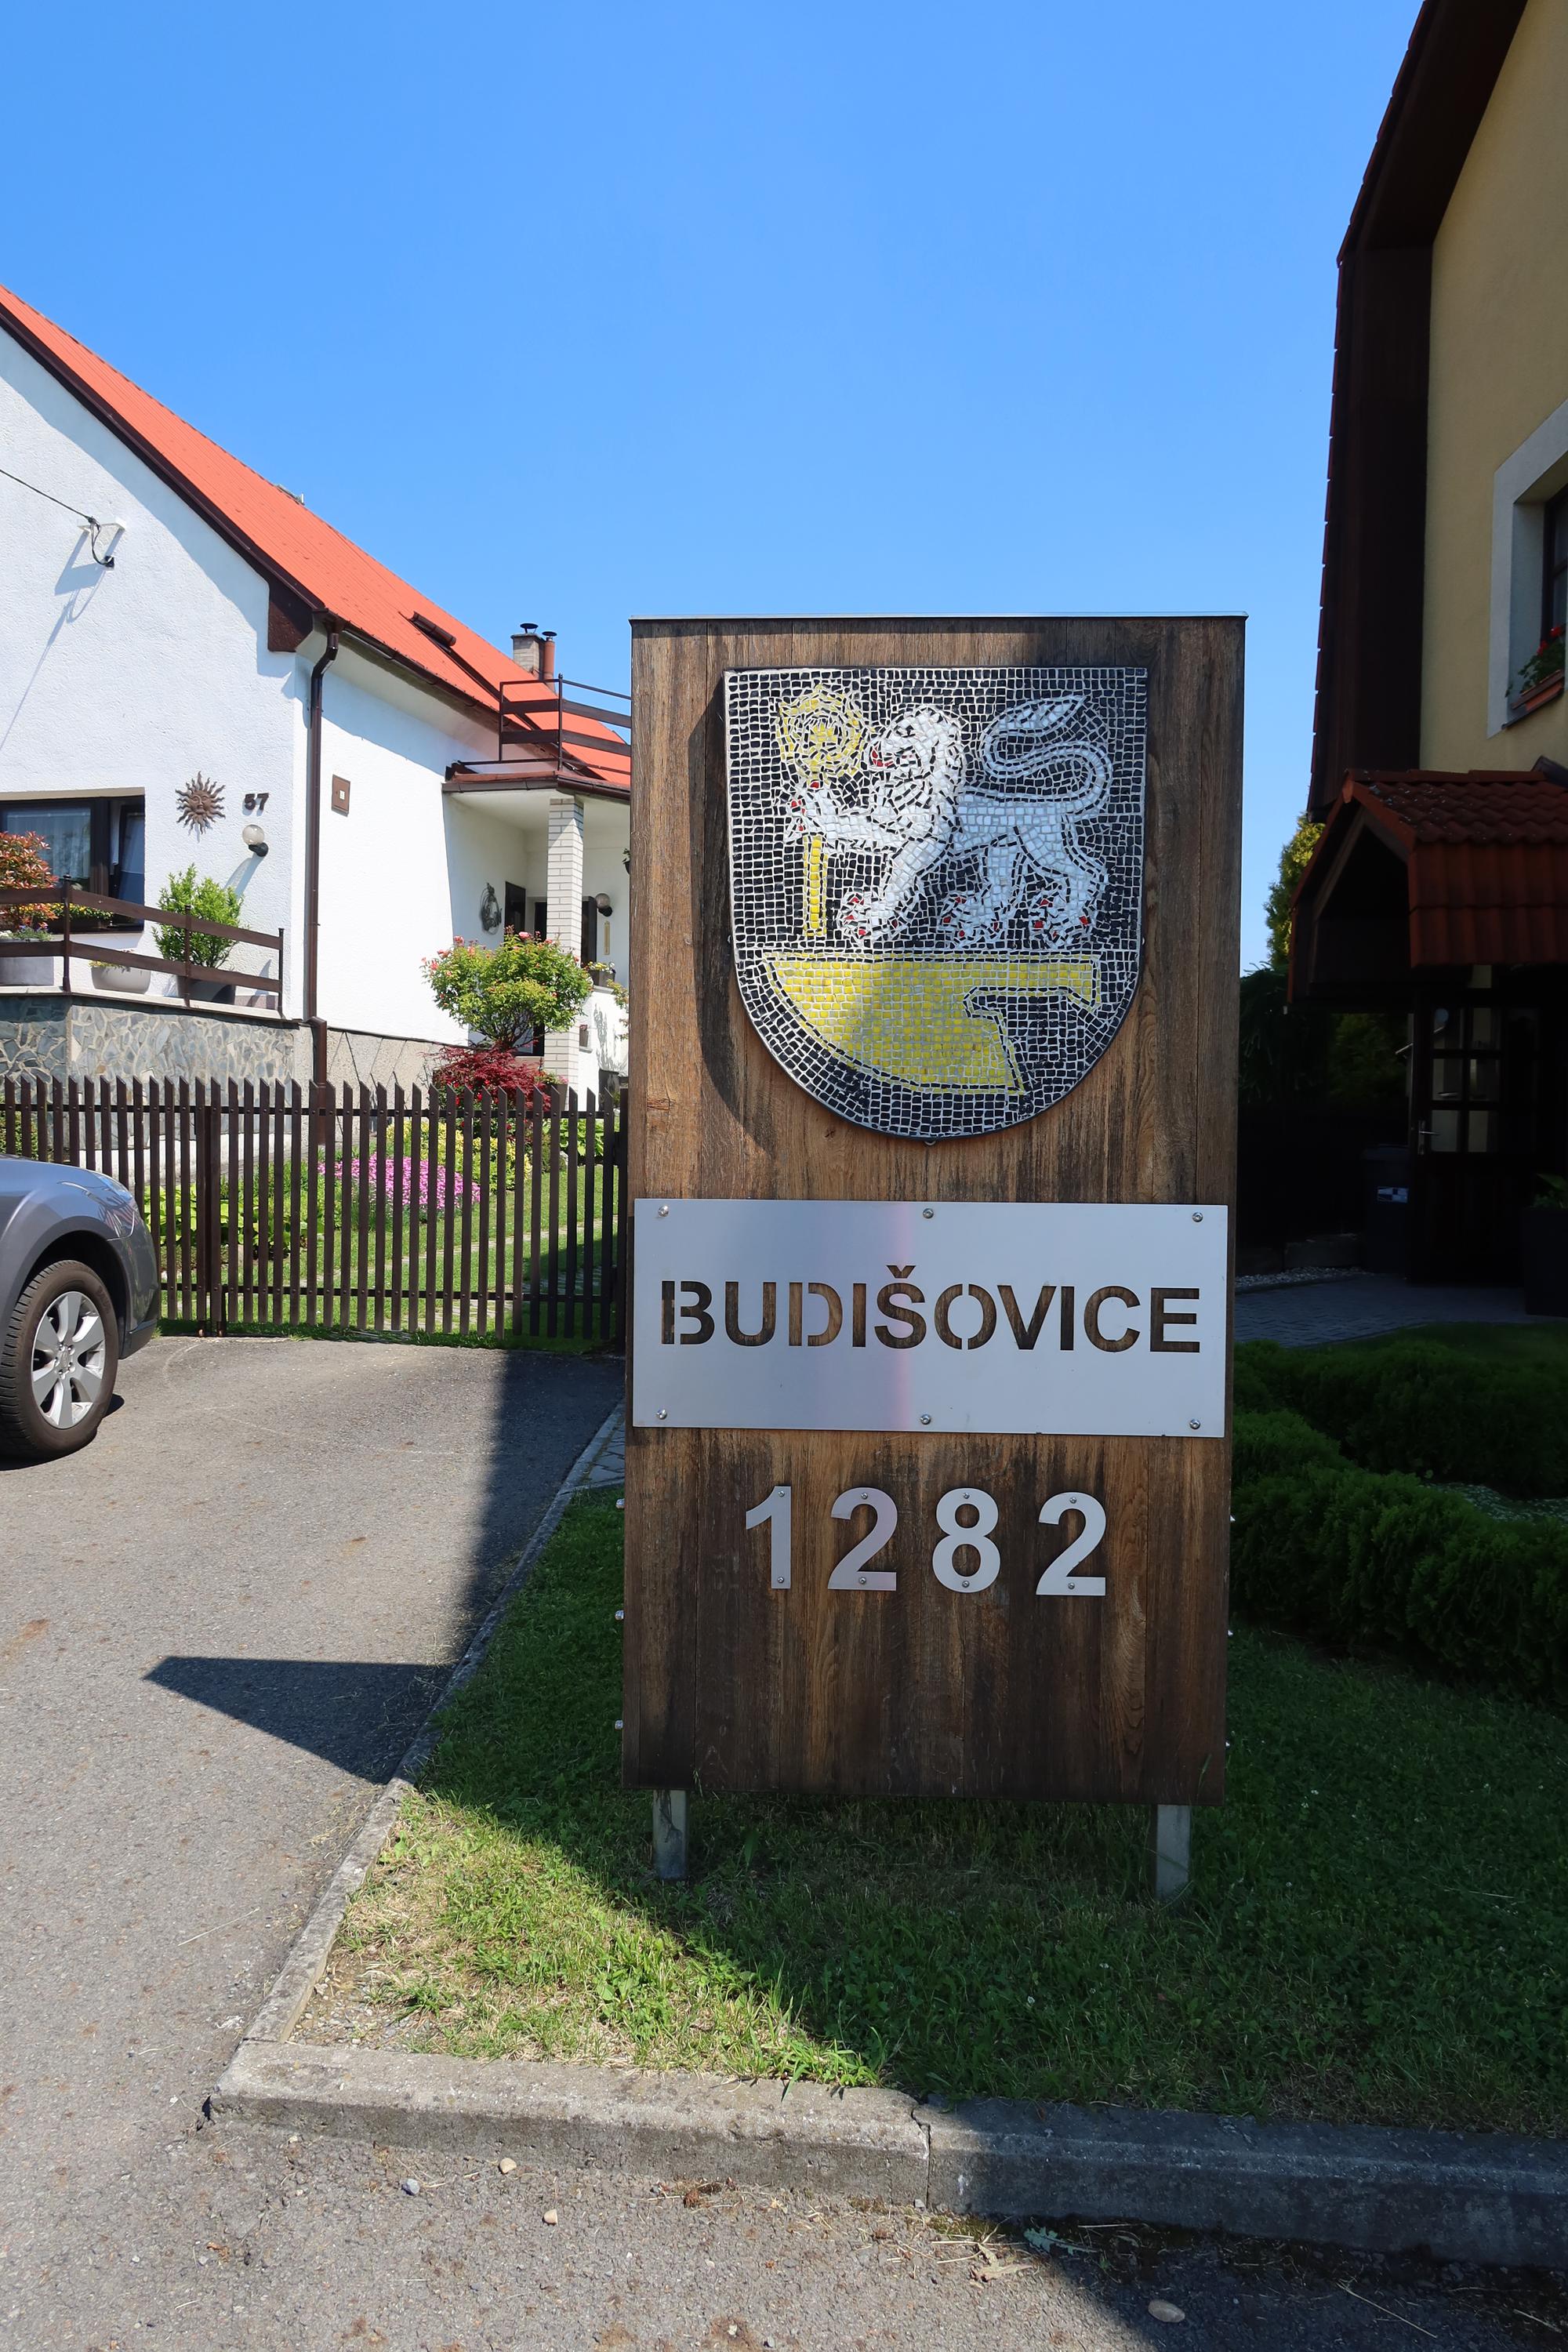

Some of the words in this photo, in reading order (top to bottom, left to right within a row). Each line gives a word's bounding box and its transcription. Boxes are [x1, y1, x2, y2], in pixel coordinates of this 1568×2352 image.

[244, 793, 270, 811] 57
[661, 1265, 1200, 1353] BUDIŠOVICE
[745, 1486, 1107, 1596] 1282
